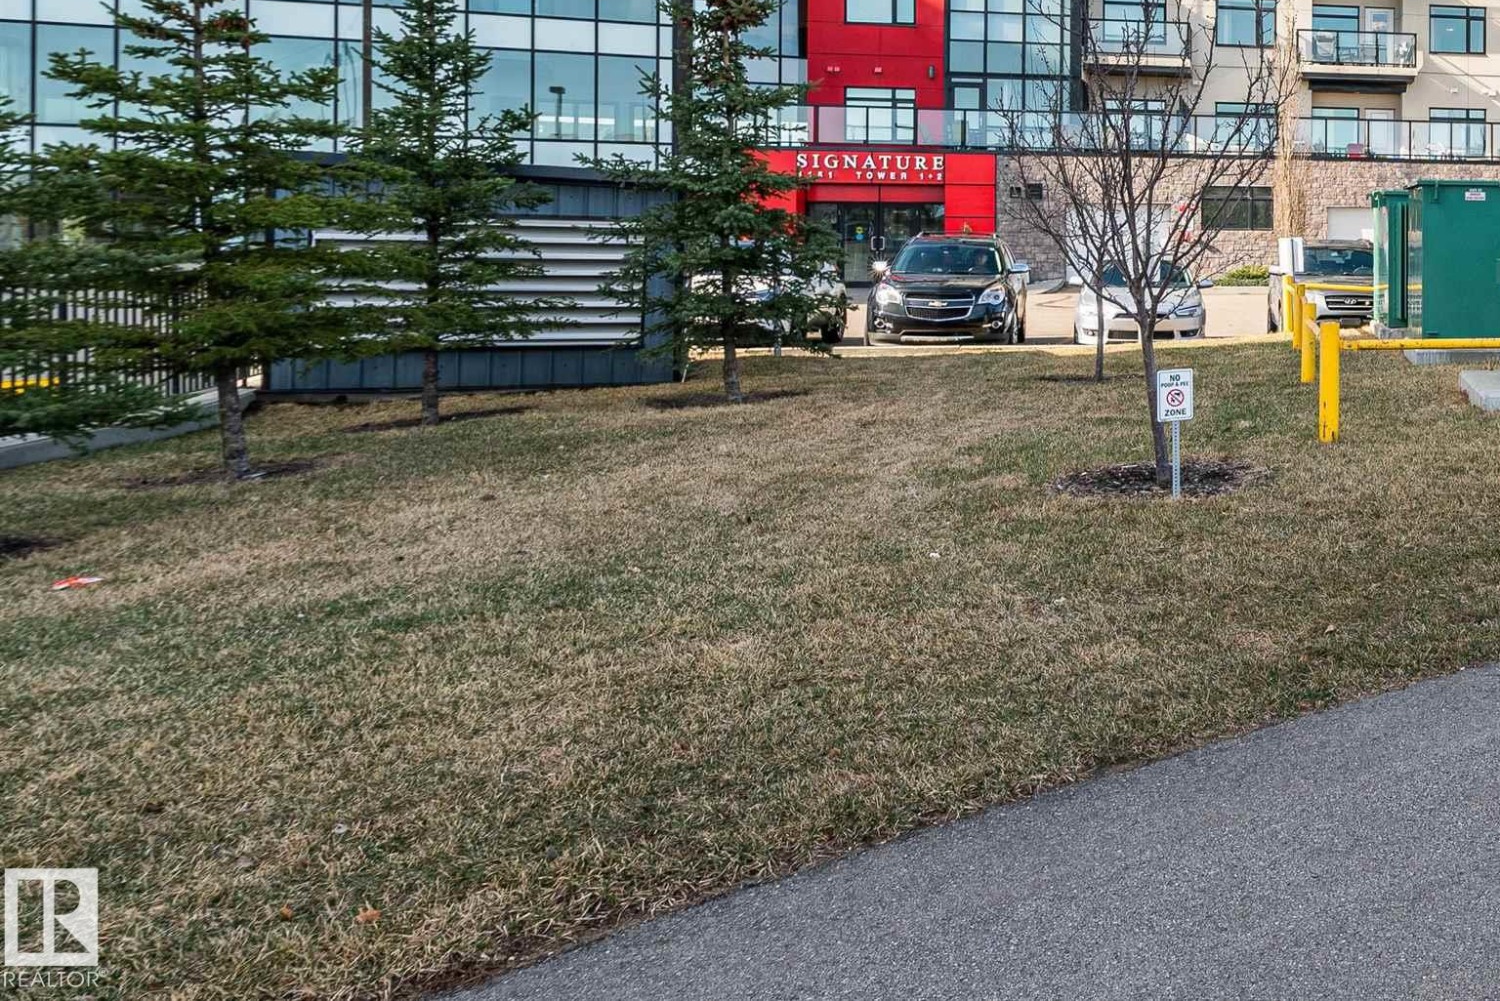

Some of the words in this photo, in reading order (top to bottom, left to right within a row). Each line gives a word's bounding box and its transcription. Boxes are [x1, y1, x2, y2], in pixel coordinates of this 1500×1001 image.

[797, 154, 944, 170] SIGNATURE
[856, 171, 907, 180] TOWER
[1165, 408, 1186, 416] ZONE
